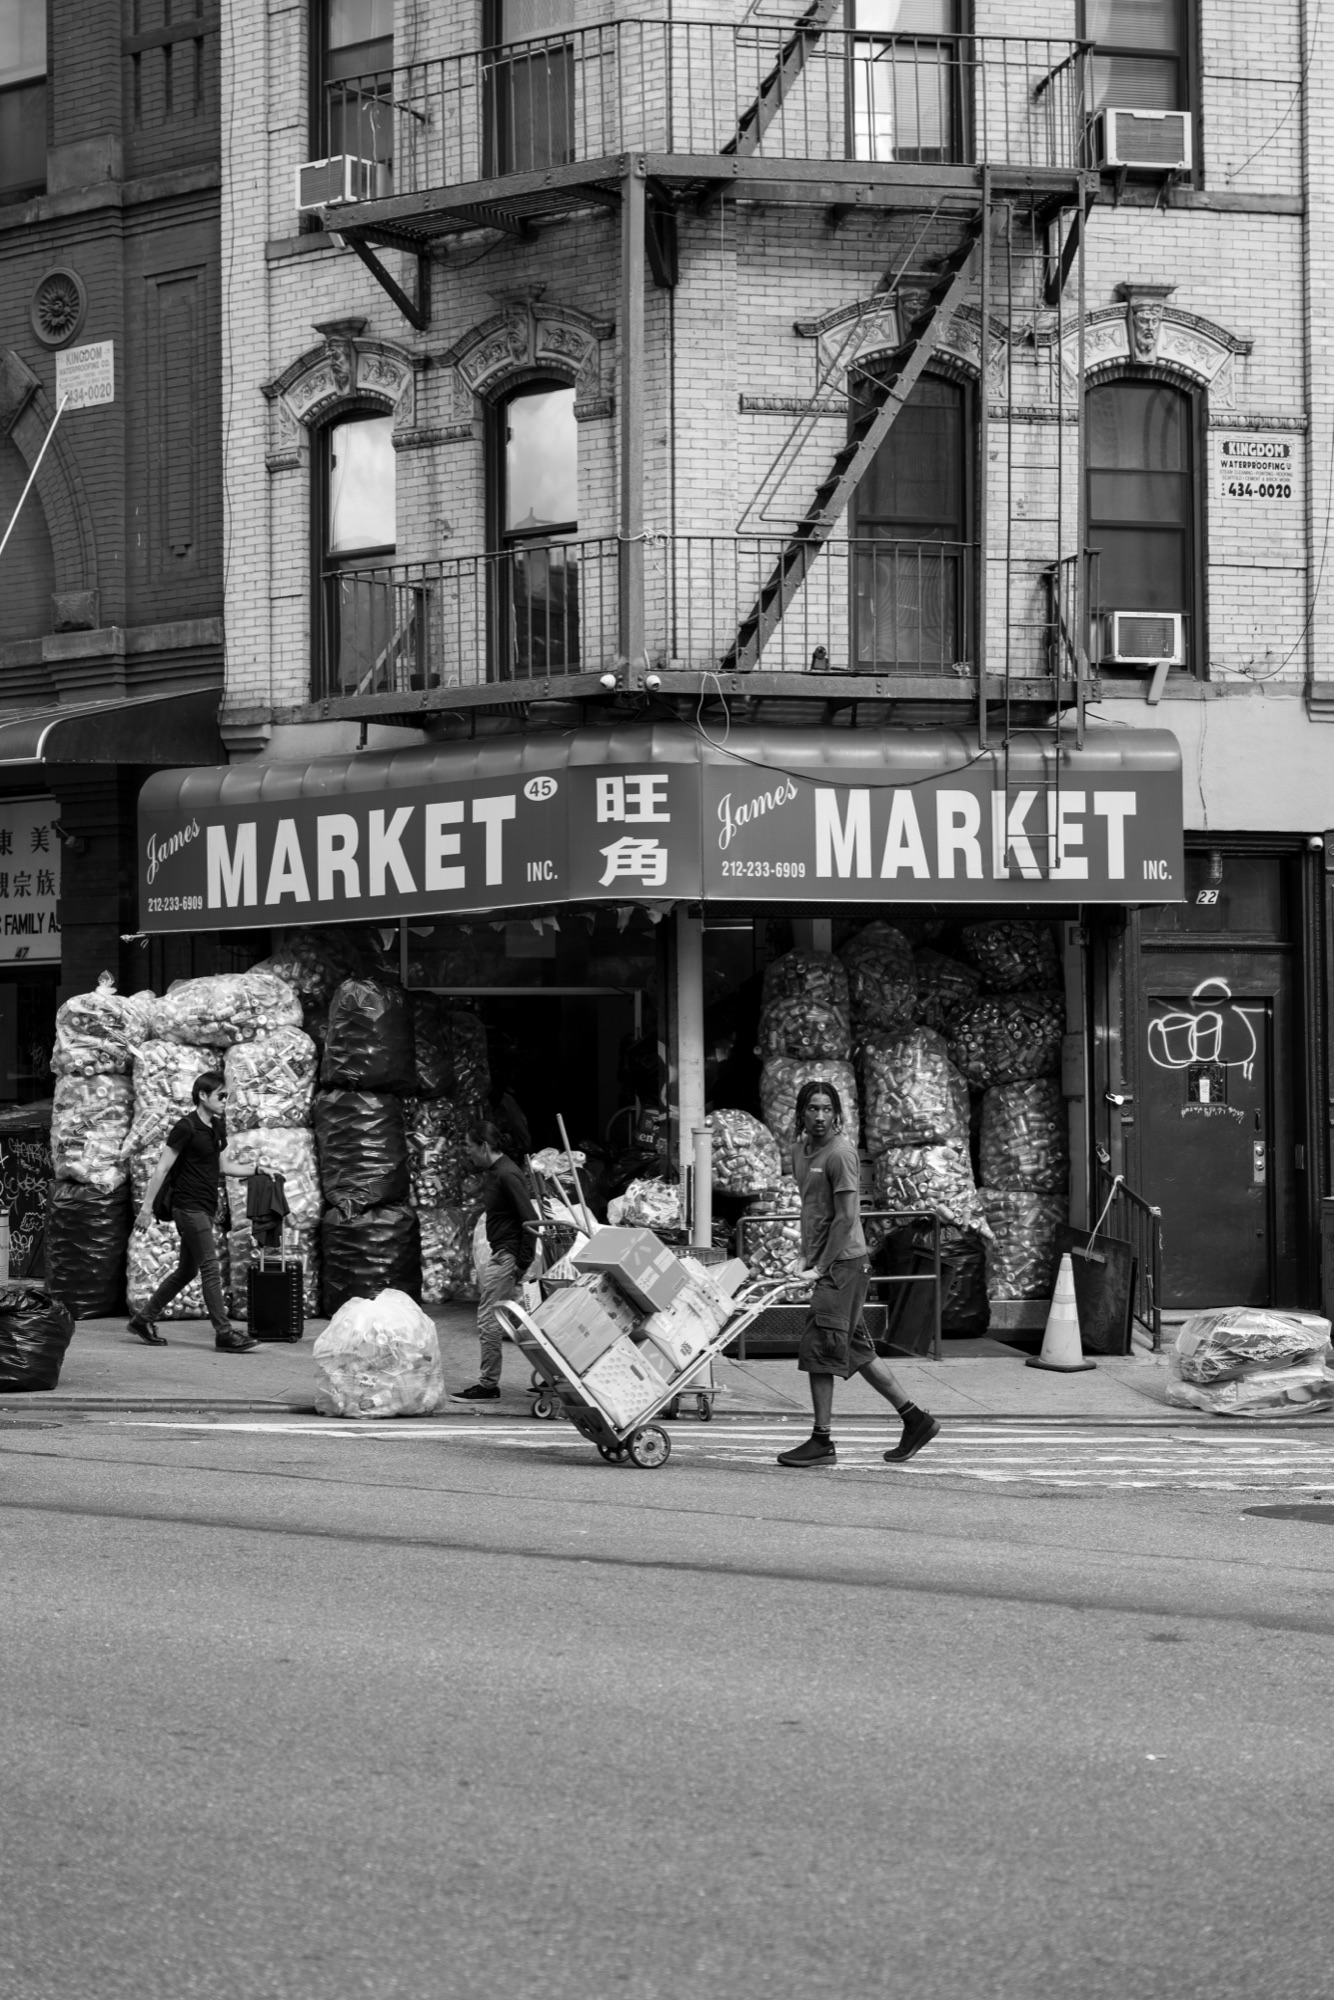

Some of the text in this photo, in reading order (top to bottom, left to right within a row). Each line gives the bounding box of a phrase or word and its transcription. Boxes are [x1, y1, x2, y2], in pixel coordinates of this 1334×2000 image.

[66, 346, 102, 366] KINGDOM
[60, 361, 99, 376] WATERPROOFING
[1228, 442, 1284, 457] KINGDOM
[1220, 460, 1285, 470] WATERPROOFING
[1228, 482, 1292, 498] 434-0020
[529, 780, 553, 797] 45
[596, 774, 671, 887] 旺角
[717, 778, 1173, 880] James MARKET INC.
[146, 794, 559, 909] James MARKET INC.
[721, 861, 806, 878] 212-233-6909
[148, 895, 203, 912] 212-233-6909
[1197, 891, 1218, 903] 22
[5, 912, 46, 936] FAMILY
[14, 947, 30, 959] 47
